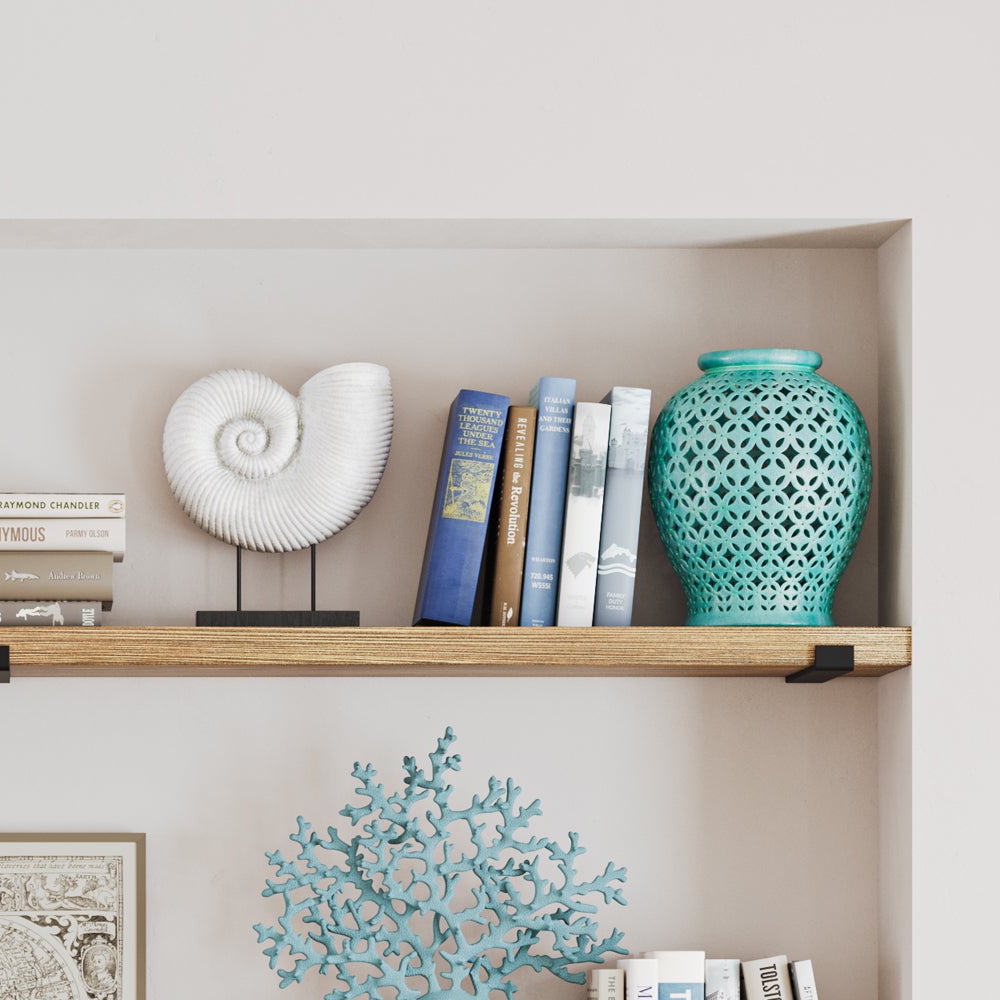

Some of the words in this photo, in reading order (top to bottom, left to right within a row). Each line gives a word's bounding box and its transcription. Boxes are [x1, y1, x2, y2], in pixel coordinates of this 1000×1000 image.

[544, 396, 571, 404] ITALIAN
[463, 407, 503, 419] TWENTY
[545, 406, 568, 414] VILLAS
[458, 415, 504, 427] THOUSAND
[460, 422, 499, 434] LEAGUES
[540, 425, 570, 433] GARDENS
[463, 430, 494, 440] UNDER
[458, 438, 478, 447] THE
[478, 439, 496, 449] SEA
[513, 417, 528, 469] REVEALING
[512, 471, 521, 484] the
[49, 502, 100, 510] CHANDLER
[507, 486, 523, 545] Revolution
[65, 529, 88, 538] PARMY
[89, 529, 109, 538] OLSON
[48, 570, 76, 580] Andrew
[82, 608, 95, 626] DOYLE
[608, 976, 616, 993] THE
